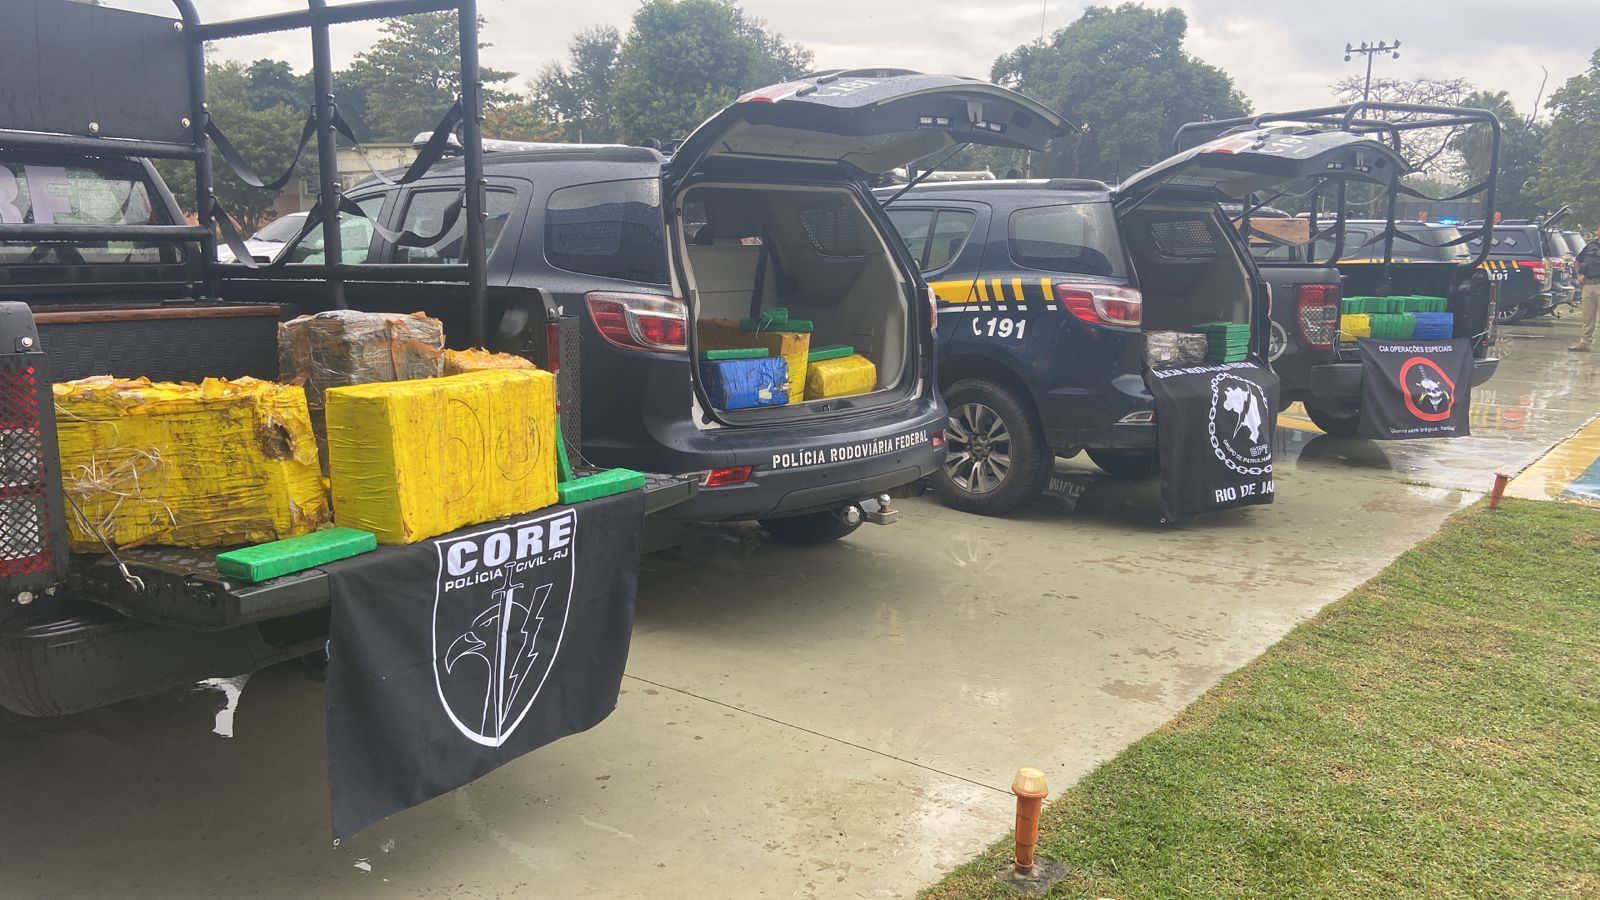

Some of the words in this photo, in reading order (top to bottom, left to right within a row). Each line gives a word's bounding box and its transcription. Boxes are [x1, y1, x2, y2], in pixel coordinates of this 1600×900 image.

[987, 317, 1026, 339] 191
[772, 449, 826, 469] POLÍCIA
[830, 439, 894, 462] RODOVIÁRIA
[895, 429, 928, 450] FEDERAL
[1215, 487, 1236, 502] RIO
[1240, 483, 1256, 497] DE
[447, 516, 572, 577] CORE
[445, 568, 503, 592] POLÍCIA
